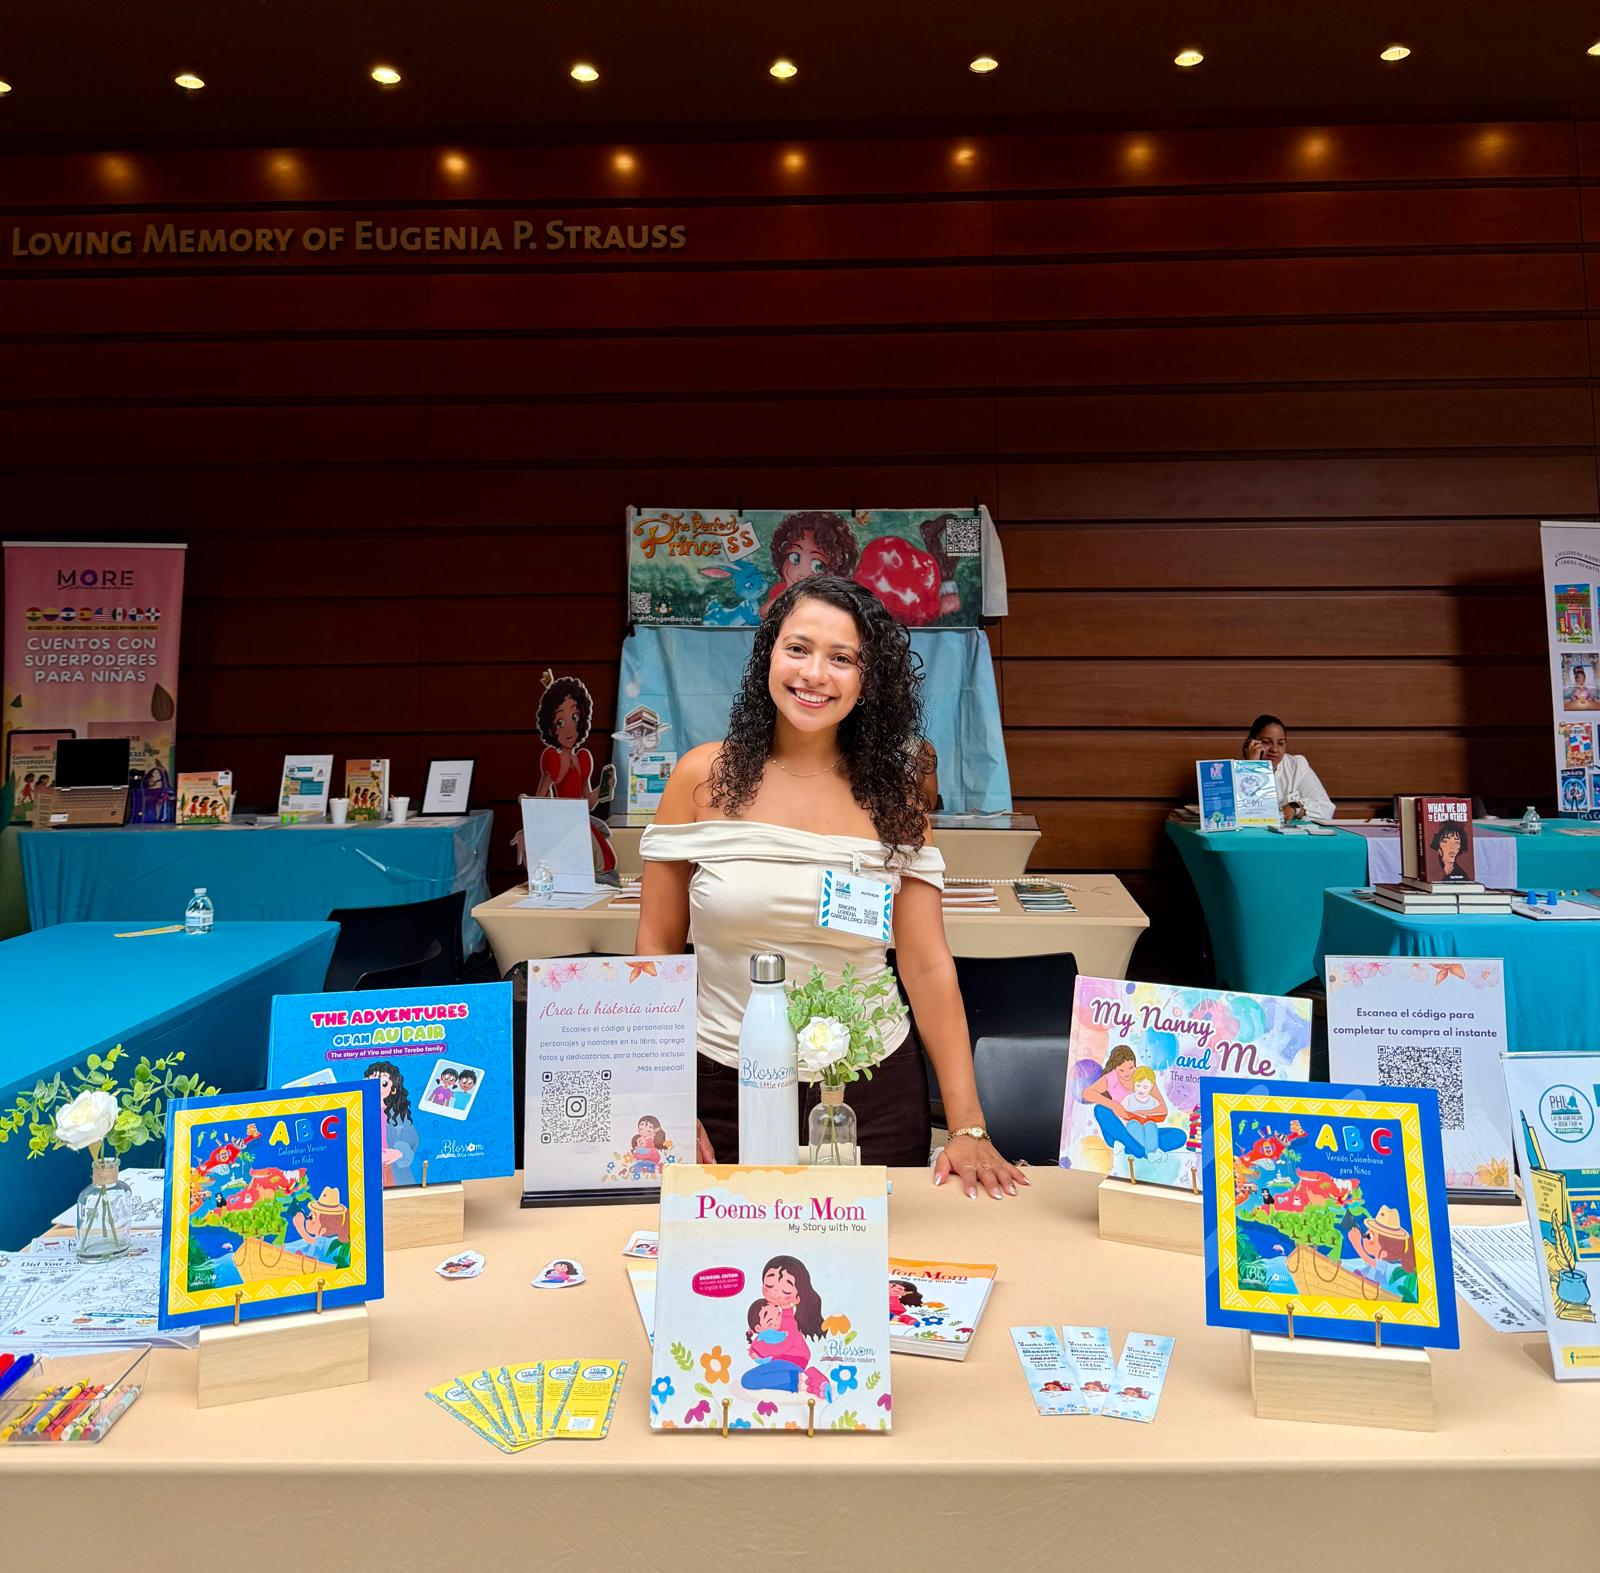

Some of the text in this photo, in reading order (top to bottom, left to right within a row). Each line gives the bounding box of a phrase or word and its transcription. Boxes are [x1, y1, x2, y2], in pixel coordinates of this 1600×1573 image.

[12, 227, 132, 256] LOVING
[143, 224, 294, 253] MEMORY
[355, 221, 503, 251] EUGENIA
[514, 220, 537, 250] P.
[546, 219, 686, 249] STRAUSS
[57, 569, 135, 587] MORE
[27, 637, 156, 651] CUENTOS CON
[24, 654, 157, 667] SUPERPODERES
[34, 666, 147, 683] PARA NIÑAS
[1428, 803, 1467, 813] WHAT WE DID
[1434, 813, 1449, 822] EACH
[1450, 813, 1468, 822] OTHER
[311, 1003, 469, 1028] THE ADVENTURES
[539, 998, 685, 1020] ¡Crea tu historia única!
[1356, 1007, 1475, 1021] Escanea el código para
[601, 1024, 625, 1034] código
[632, 1024, 674, 1033] personaliza
[1091, 1000, 1214, 1047] My Nanny
[333, 1024, 445, 1046] OF AN AU PAIR
[1333, 1025, 1498, 1038] completar tu compra al instante
[540, 1039, 580, 1048] personajes
[581, 1040, 586, 1048] y
[639, 1038, 657, 1046] libro,
[658, 1039, 685, 1047] agrega
[342, 1051, 359, 1059] story
[359, 1050, 367, 1058] of
[393, 1047, 403, 1055] the
[425, 1044, 444, 1054] family
[565, 1052, 611, 1061] dedicatorias,
[1176, 1041, 1276, 1077] and Me
[654, 1064, 685, 1072] especial!
[1170, 1072, 1200, 1083] The stor
[1549, 1095, 1568, 1108] PHL
[1349, 1153, 1384, 1165] Colombiana
[695, 1195, 867, 1221] Poems for Mom
[788, 1223, 867, 1234] My Story with You
[891, 1268, 968, 1281] for Mom
[827, 1339, 876, 1356] Blossom
